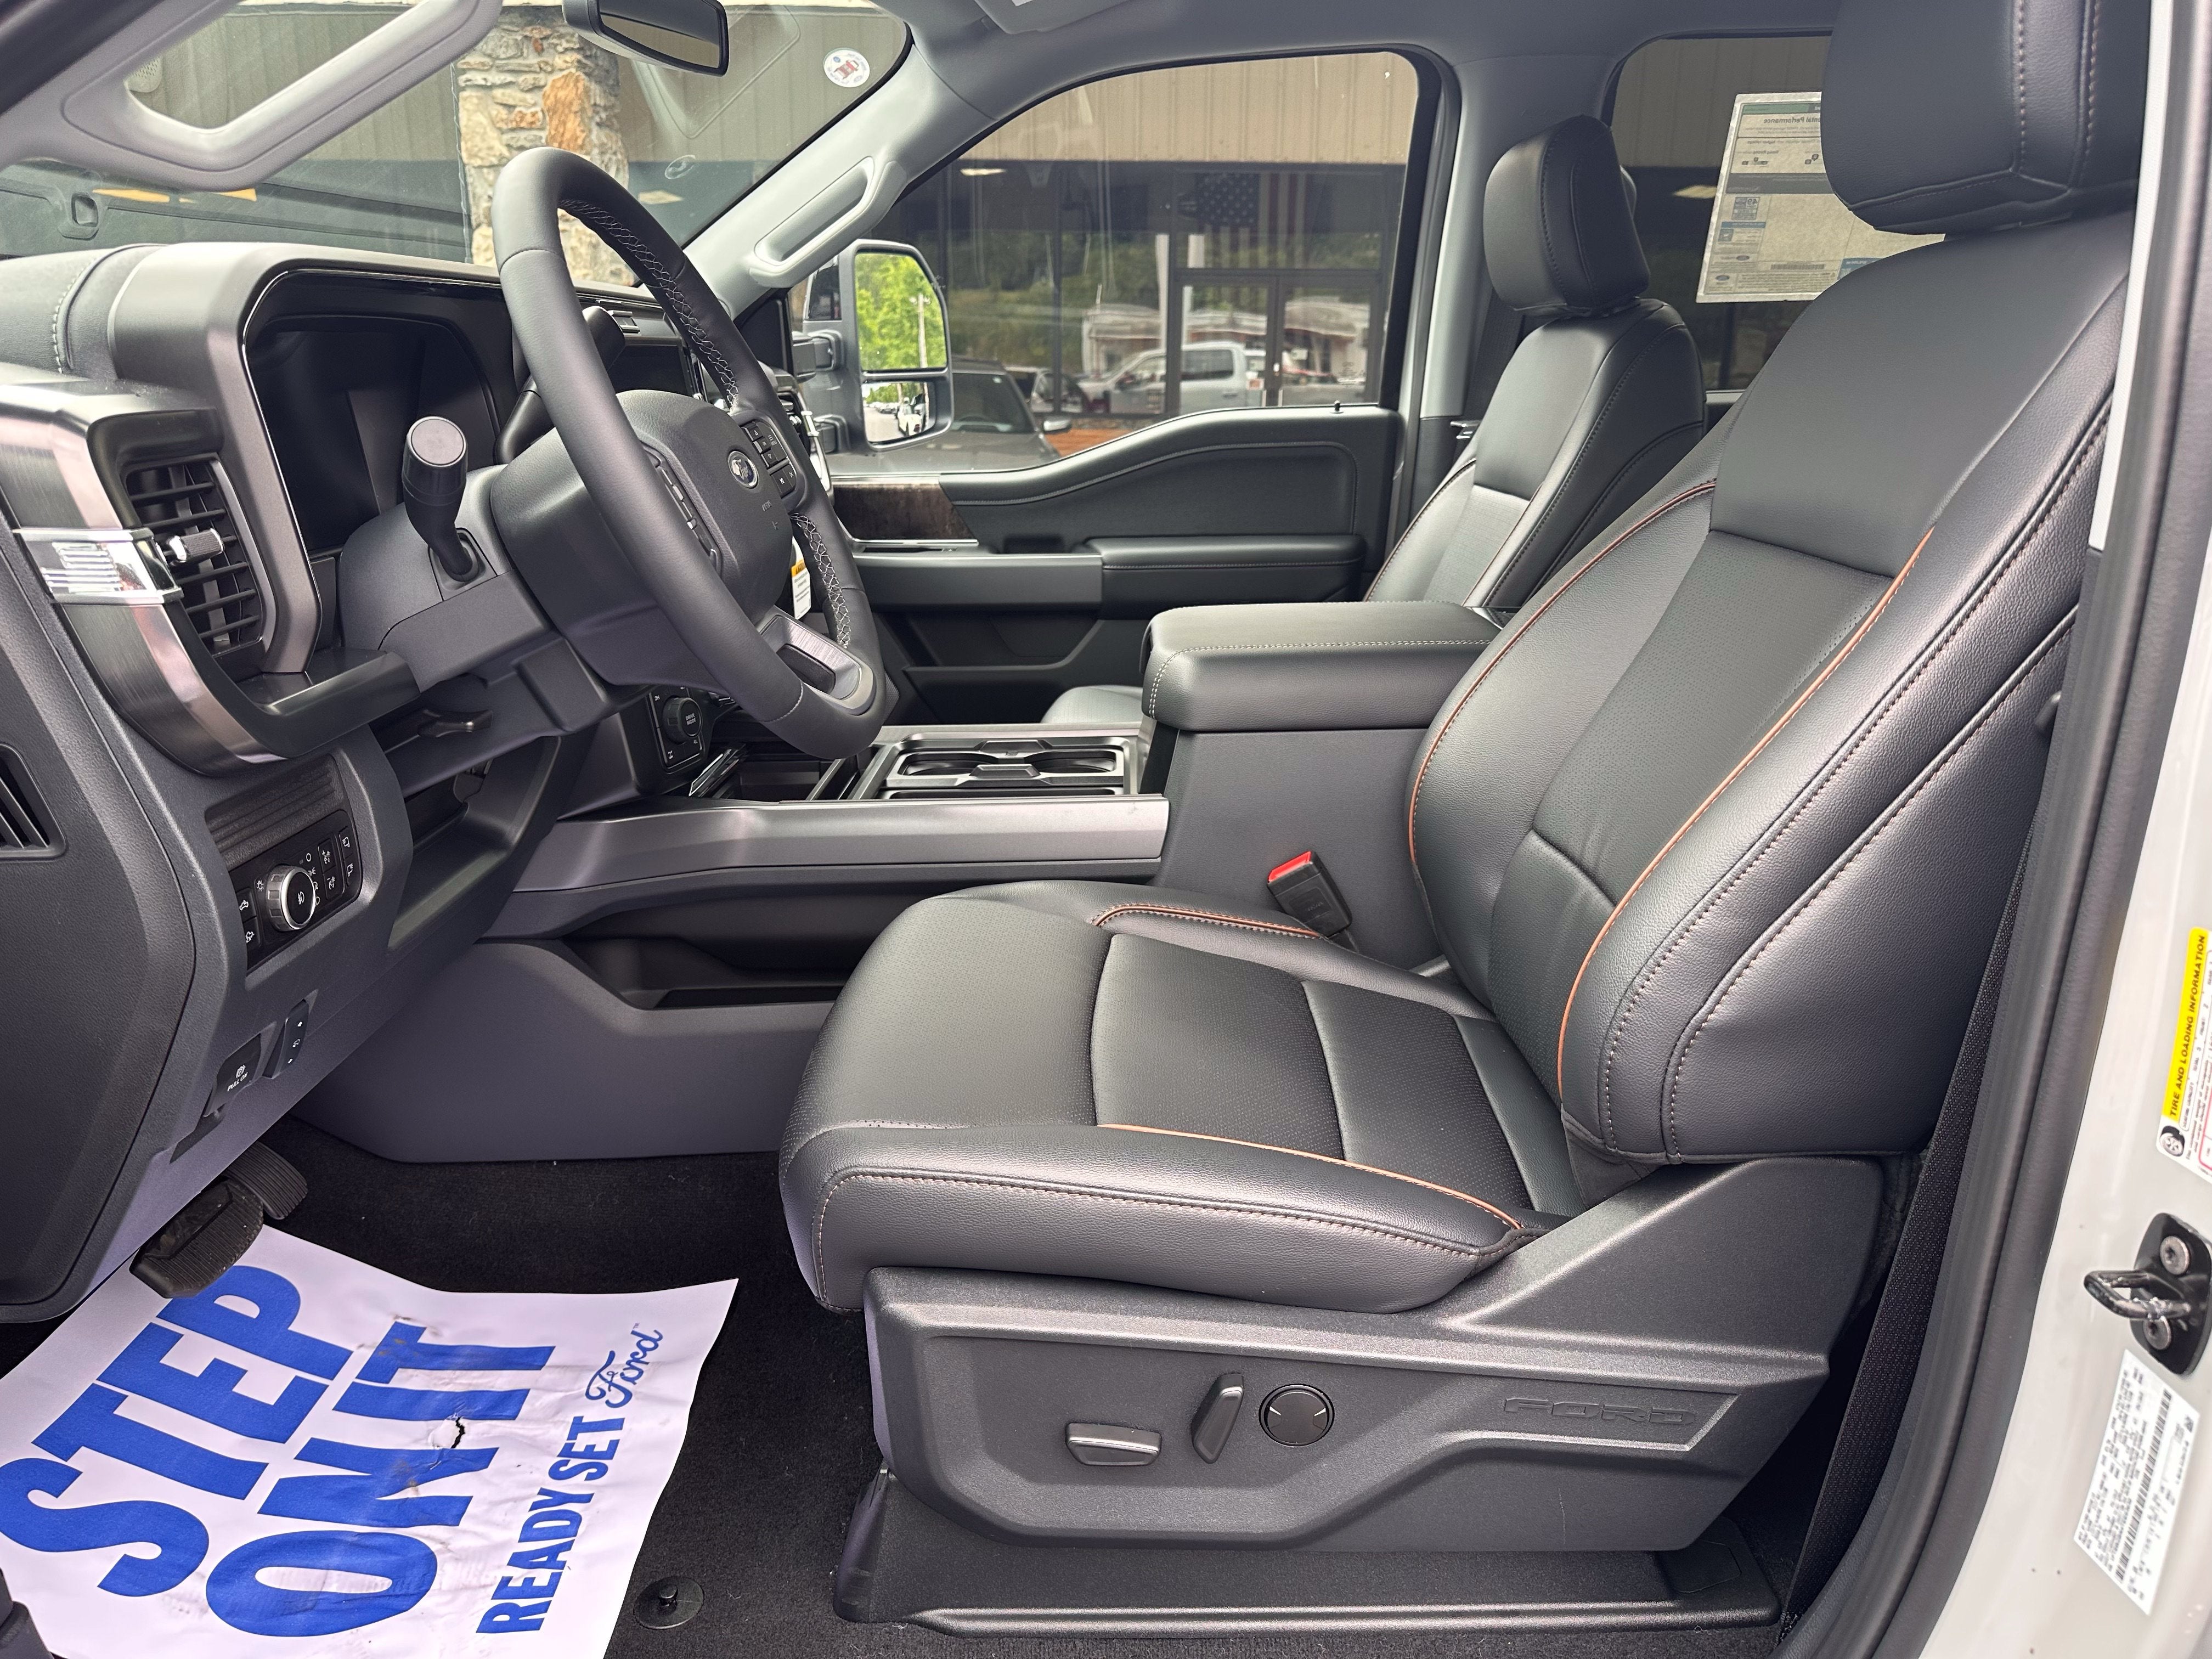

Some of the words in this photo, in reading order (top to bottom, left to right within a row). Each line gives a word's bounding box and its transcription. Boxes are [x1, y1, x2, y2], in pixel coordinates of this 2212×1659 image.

[2170, 1091, 2180, 1116] TIRE
[2175, 1066, 2185, 1090] AND
[2180, 1016, 2194, 1064] LOADING
[2188, 935, 2205, 1013] INFORMATION
[332, 1318, 555, 1421] IT
[585, 1329, 664, 1408] Ford
[1503, 1397, 1696, 1426] FORD
[0, 1265, 352, 1597] STEP
[548, 1415, 625, 1481] SET
[206, 1437, 499, 1637] ON
[476, 1488, 594, 1634] READY
